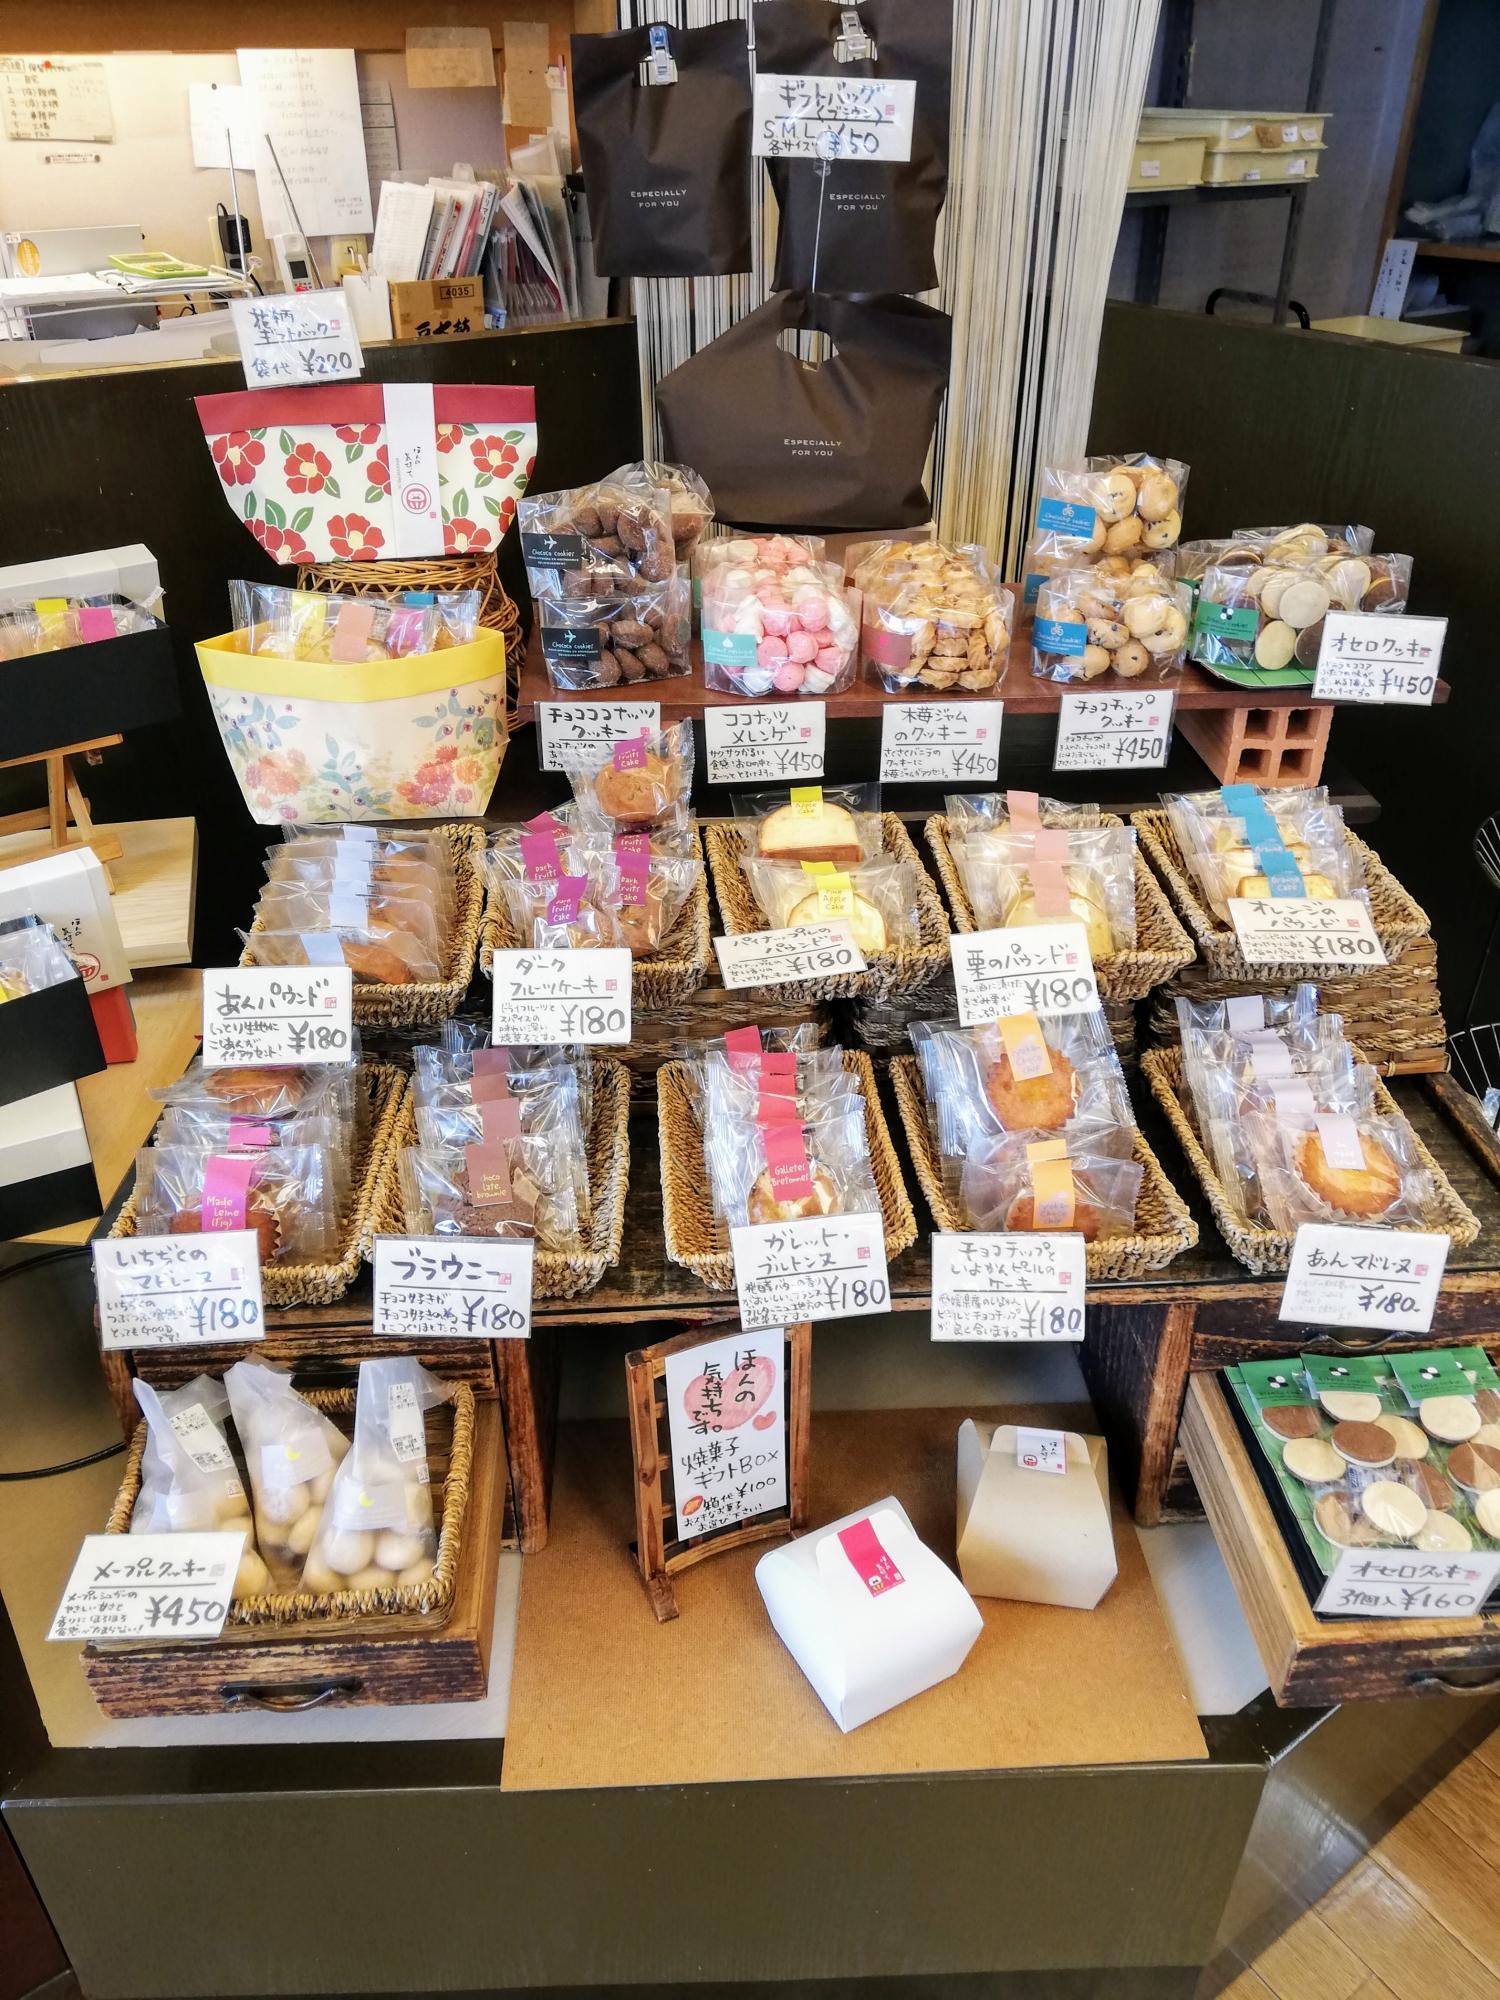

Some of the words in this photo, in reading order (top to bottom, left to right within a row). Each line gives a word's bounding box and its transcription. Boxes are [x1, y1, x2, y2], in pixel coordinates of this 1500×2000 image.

[779, 79, 886, 108] ギフトバッグ
[638, 200, 657, 208] FOR
[659, 199, 680, 208] YOU
[445, 287, 470, 297] 4035
[248, 307, 294, 330] 花柄
[252, 357, 293, 378] 袋代
[298, 348, 353, 376] ¥220
[792, 449, 810, 457] FOR
[812, 449, 834, 457] YOU
[1331, 632, 1433, 657] オセロクッキー
[1379, 668, 1434, 696] ¥450
[900, 706, 968, 724] 木苺ジャム
[1074, 694, 1156, 715] チョコチップ
[571, 723, 628, 739] クッキー
[721, 710, 789, 727] ココナッツ
[1101, 713, 1143, 728] クッキー
[732, 725, 796, 745] メレンゲ
[894, 724, 967, 741] のクッキー
[774, 749, 823, 774] ¥450
[952, 748, 998, 777] ¥450
[1112, 737, 1164, 764] ¥450
[1248, 900, 1336, 916] オレンジの
[1270, 916, 1340, 929] パウンド
[733, 927, 832, 946] パイナップルの
[765, 935, 829, 954] パウンド
[1306, 935, 1376, 959] ¥180
[515, 955, 566, 976] ダーク
[785, 948, 853, 975] ¥180
[966, 943, 1069, 979] 栗のパウンド
[214, 978, 330, 1017] あんパウンド
[509, 975, 598, 997] フルーツケーキ
[1024, 977, 1093, 1011] ¥180
[559, 1004, 626, 1038] ¥180
[287, 1020, 347, 1055] ¥180
[206, 1196, 233, 1207] Made
[115, 1244, 208, 1267] いちぢくの
[958, 1241, 1056, 1261] チョコチップと
[1307, 1248, 1412, 1274] あんマドレーヌ
[390, 1247, 501, 1281] ブラウニー
[757, 1252, 837, 1276] ブルトンヌ
[950, 1260, 1055, 1277] いよかんピールの
[823, 1275, 886, 1311] ¥180
[988, 1277, 1032, 1290] ケーキ
[379, 1291, 450, 1305] チョコ好きが
[190, 1296, 259, 1336] ¥180
[462, 1295, 526, 1332] ¥180
[1020, 1299, 1082, 1338] ¥180
[734, 1349, 757, 1403] ほんの
[700, 1361, 724, 1418] 気持ち
[681, 1436, 740, 1476] 焼菓子
[693, 1449, 780, 1489] ギフトBOX
[702, 1492, 734, 1512] 箱代
[735, 1476, 777, 1499] ¥100
[93, 1557, 206, 1582] メープルクッキー
[1336, 1587, 1397, 1607] 3個入
[1400, 1585, 1476, 1611] ¥160
[144, 1595, 225, 1628] ¥450
